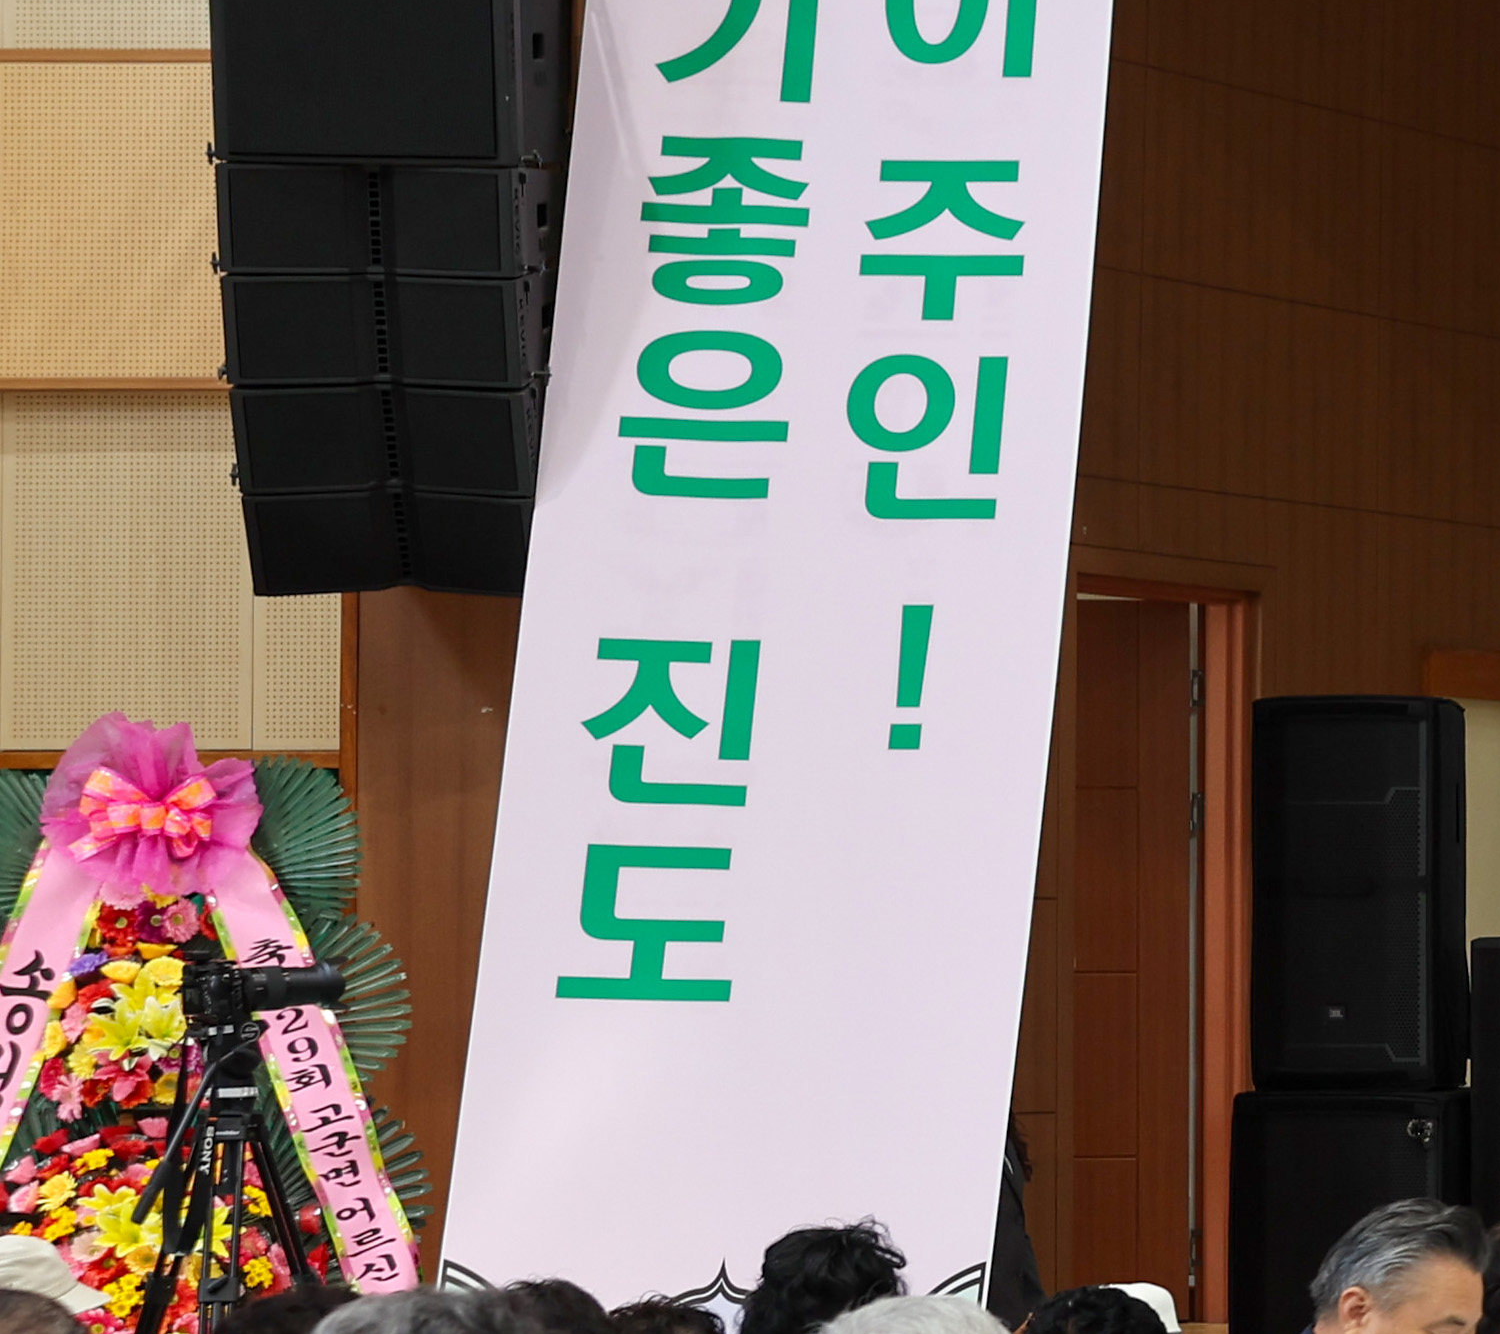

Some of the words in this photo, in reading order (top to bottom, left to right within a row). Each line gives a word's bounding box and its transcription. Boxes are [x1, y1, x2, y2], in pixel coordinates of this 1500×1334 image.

[847, 160, 1024, 519] 주인
[556, 638, 761, 1002] 진도
[199, 1126, 216, 1176] SONY
[302, 1102, 362, 1188] 고군면
[336, 1197, 400, 1282] 어르신
